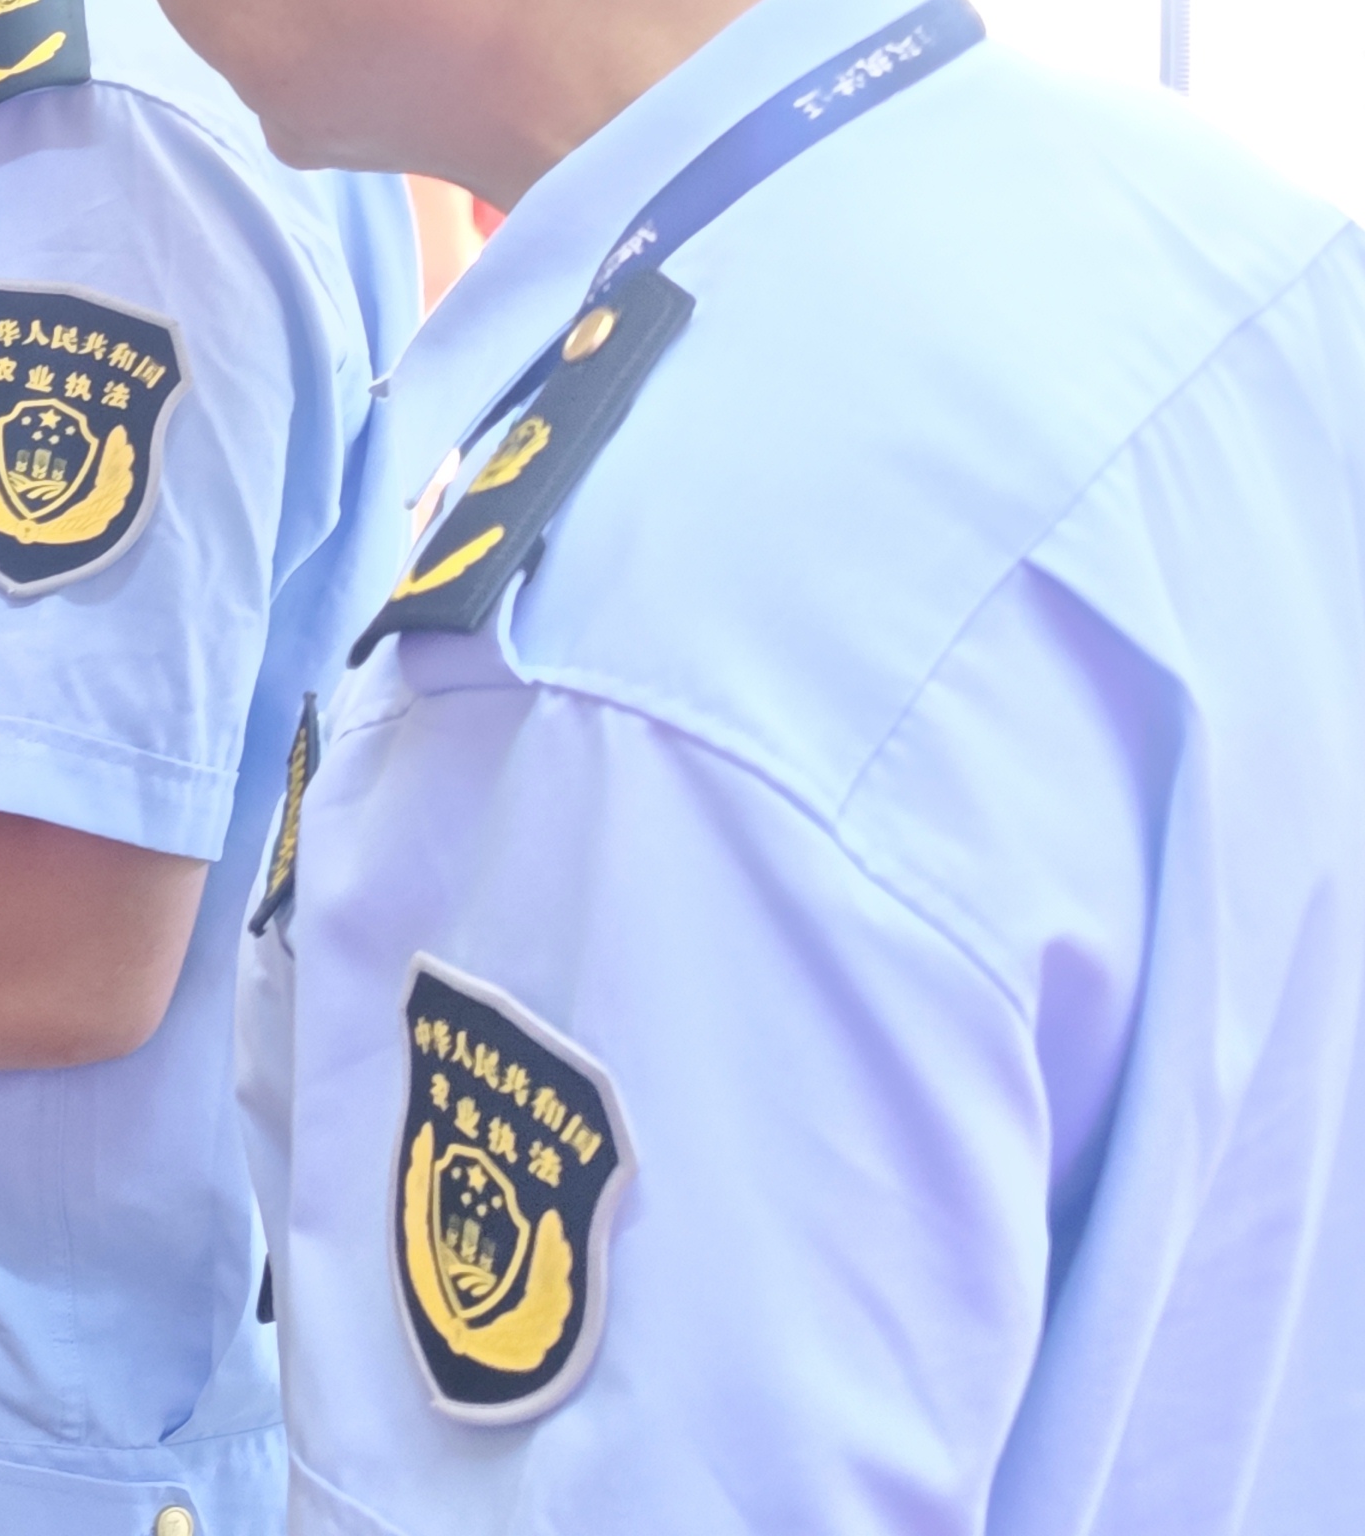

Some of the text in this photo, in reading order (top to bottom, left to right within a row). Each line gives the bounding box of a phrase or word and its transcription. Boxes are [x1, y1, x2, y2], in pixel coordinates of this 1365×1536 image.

[415, 1014, 603, 1168] 中华人民共和国
[430, 1071, 564, 1189] 农业执法
